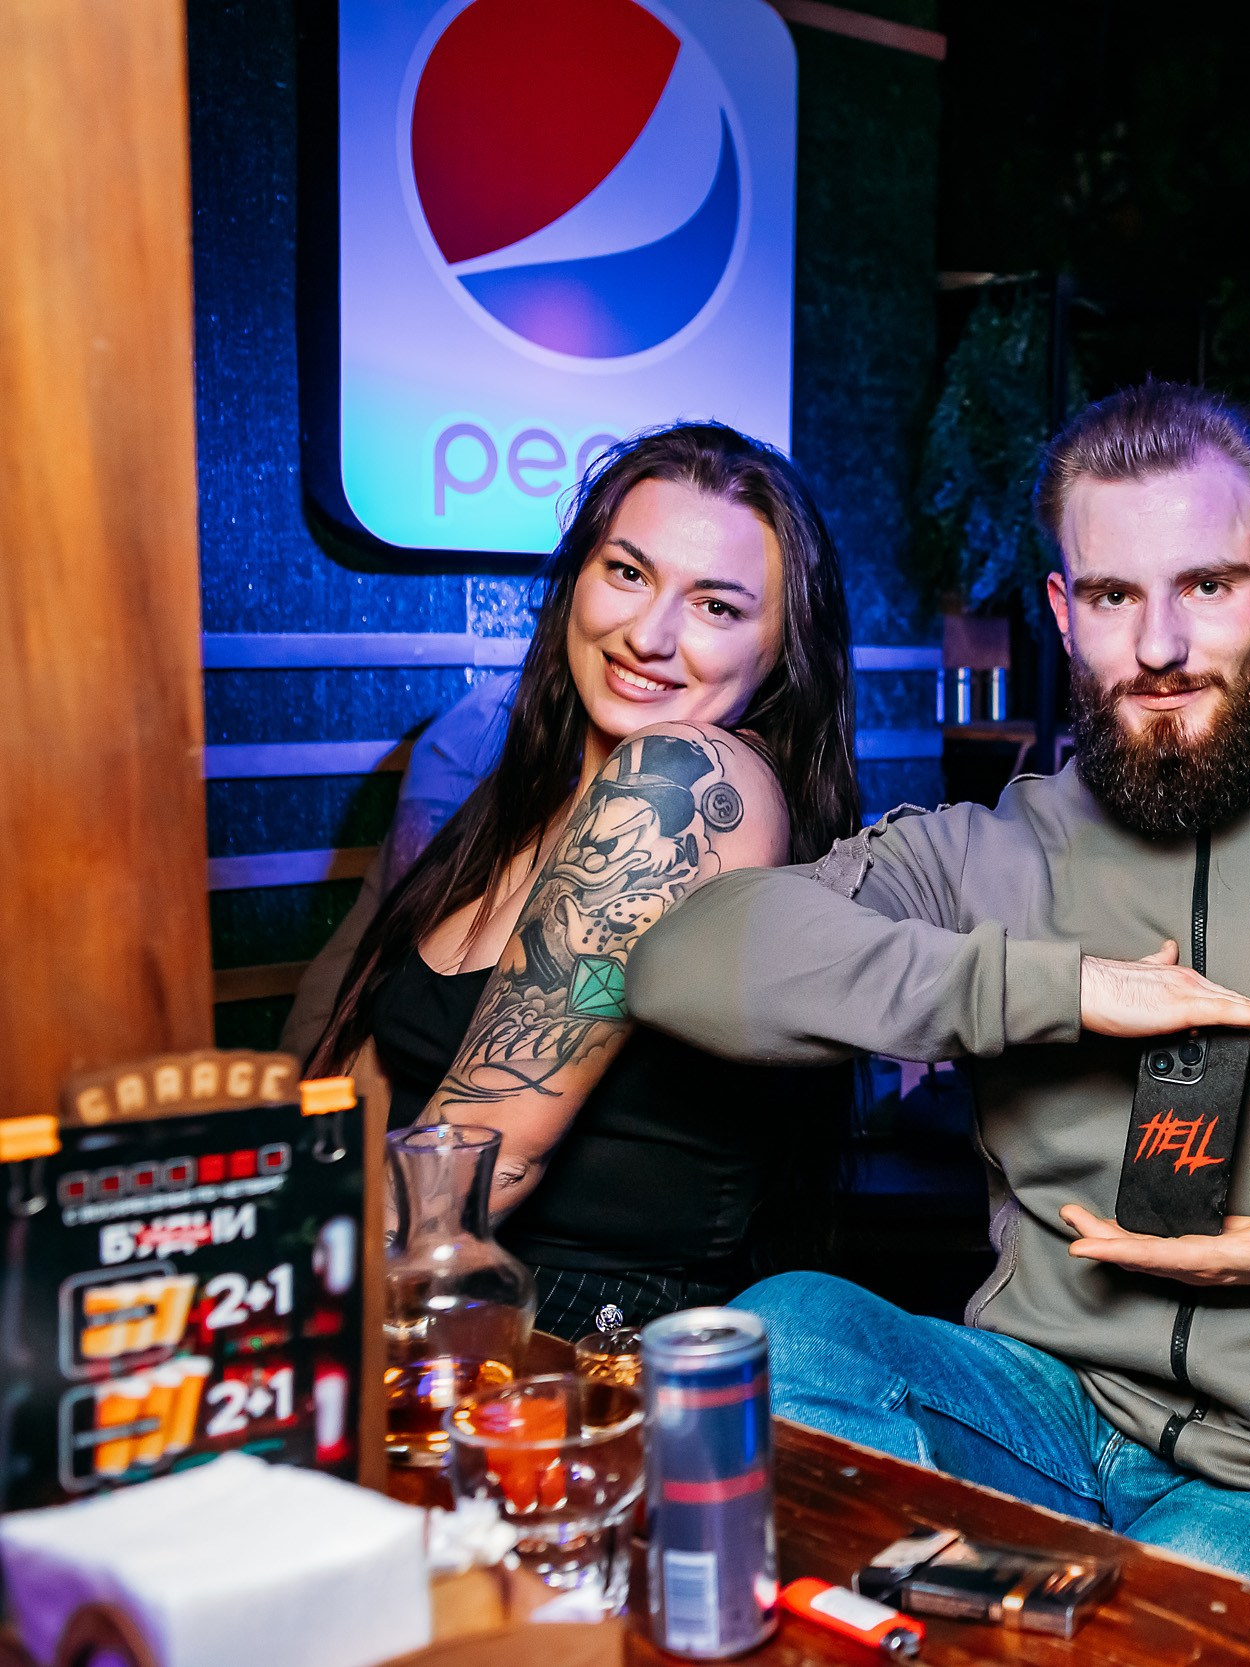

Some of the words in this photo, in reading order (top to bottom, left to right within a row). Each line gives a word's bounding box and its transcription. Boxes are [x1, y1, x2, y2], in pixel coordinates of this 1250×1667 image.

[1133, 1108, 1226, 1176] HELL
[205, 1262, 294, 1330] 2+1
[205, 1367, 294, 1437] 2+1
